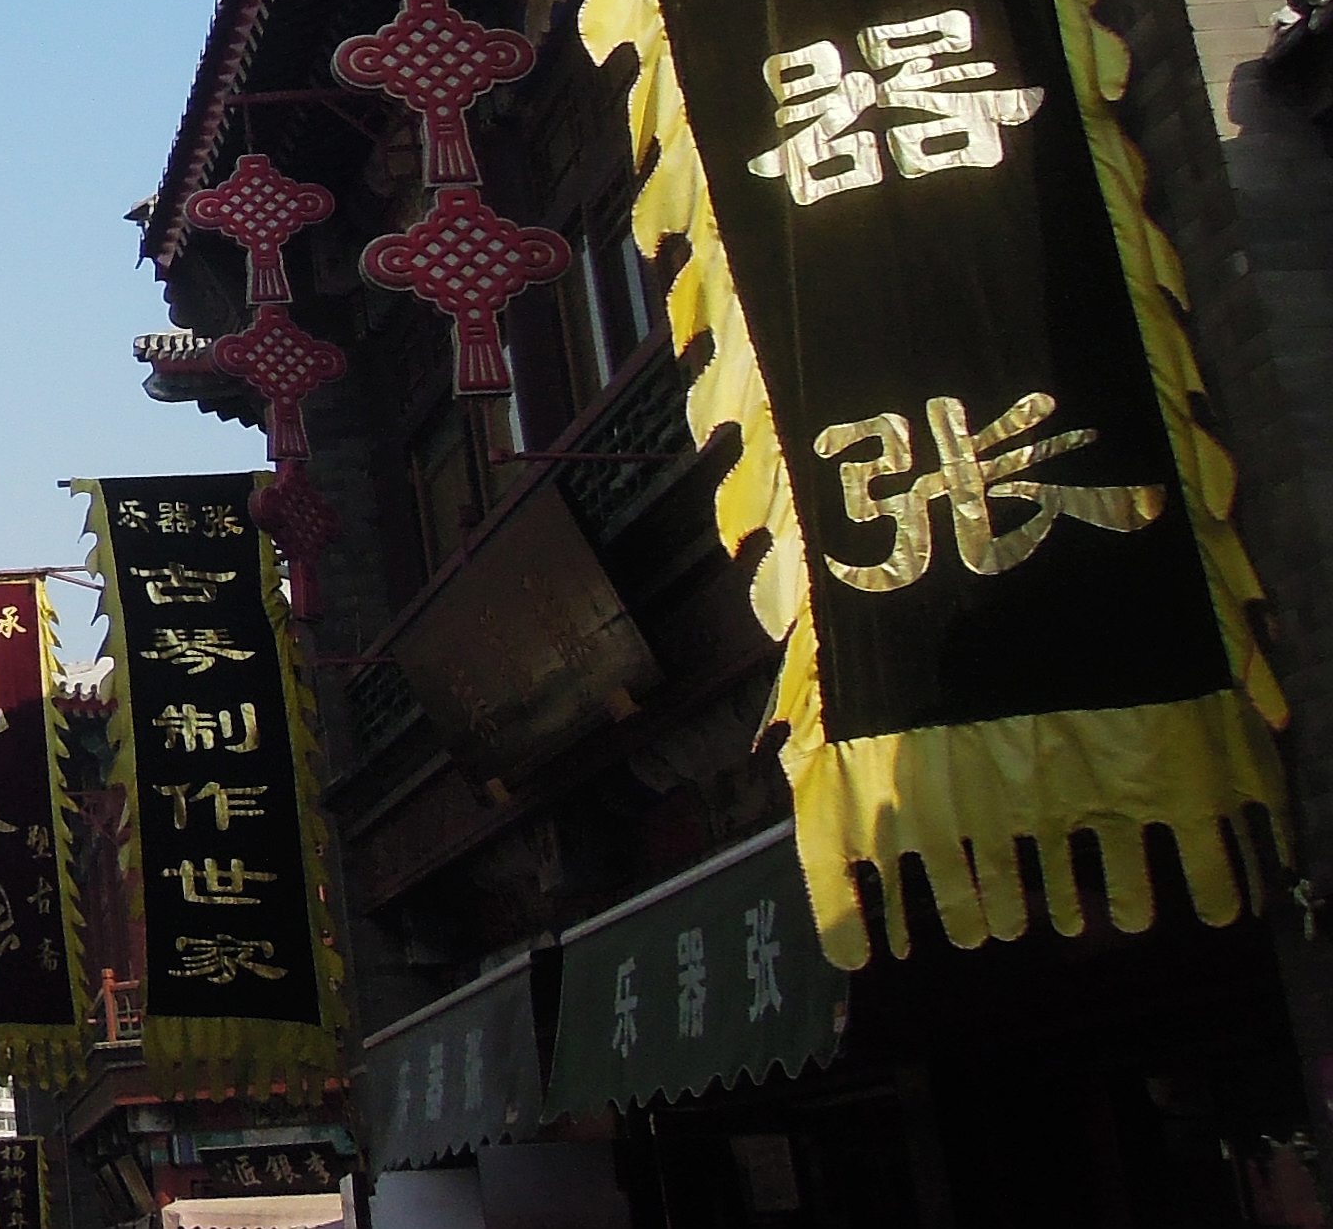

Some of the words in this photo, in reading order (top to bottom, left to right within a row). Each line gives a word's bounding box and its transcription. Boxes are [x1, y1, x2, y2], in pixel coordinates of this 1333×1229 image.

[116, 500, 245, 535] 乐器张
[130, 562, 288, 984] 古琴制作世家
[613, 899, 782, 1058] 乐器张
